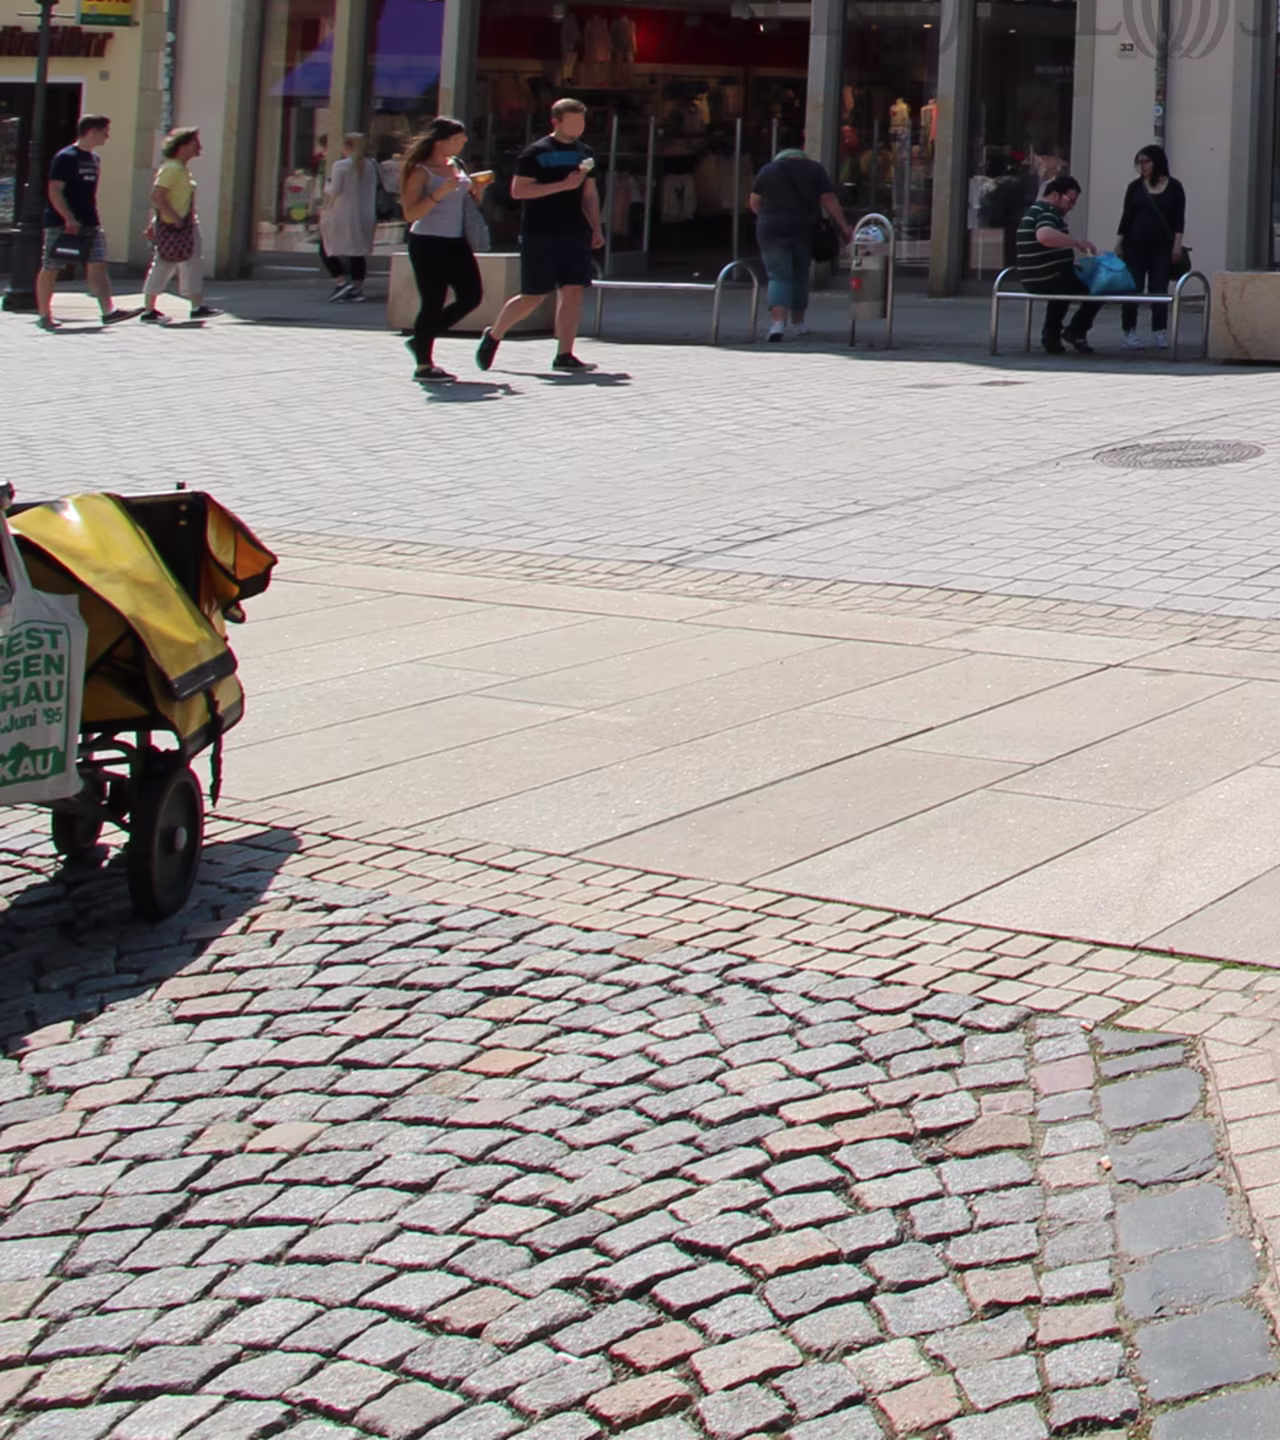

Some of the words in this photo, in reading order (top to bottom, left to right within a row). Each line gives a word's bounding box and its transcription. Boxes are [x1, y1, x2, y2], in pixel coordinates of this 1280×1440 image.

[1120, 43, 1135, 52] 33
[0, 627, 63, 658] EST
[2, 654, 65, 684] SEN
[0, 679, 65, 712] HAU
